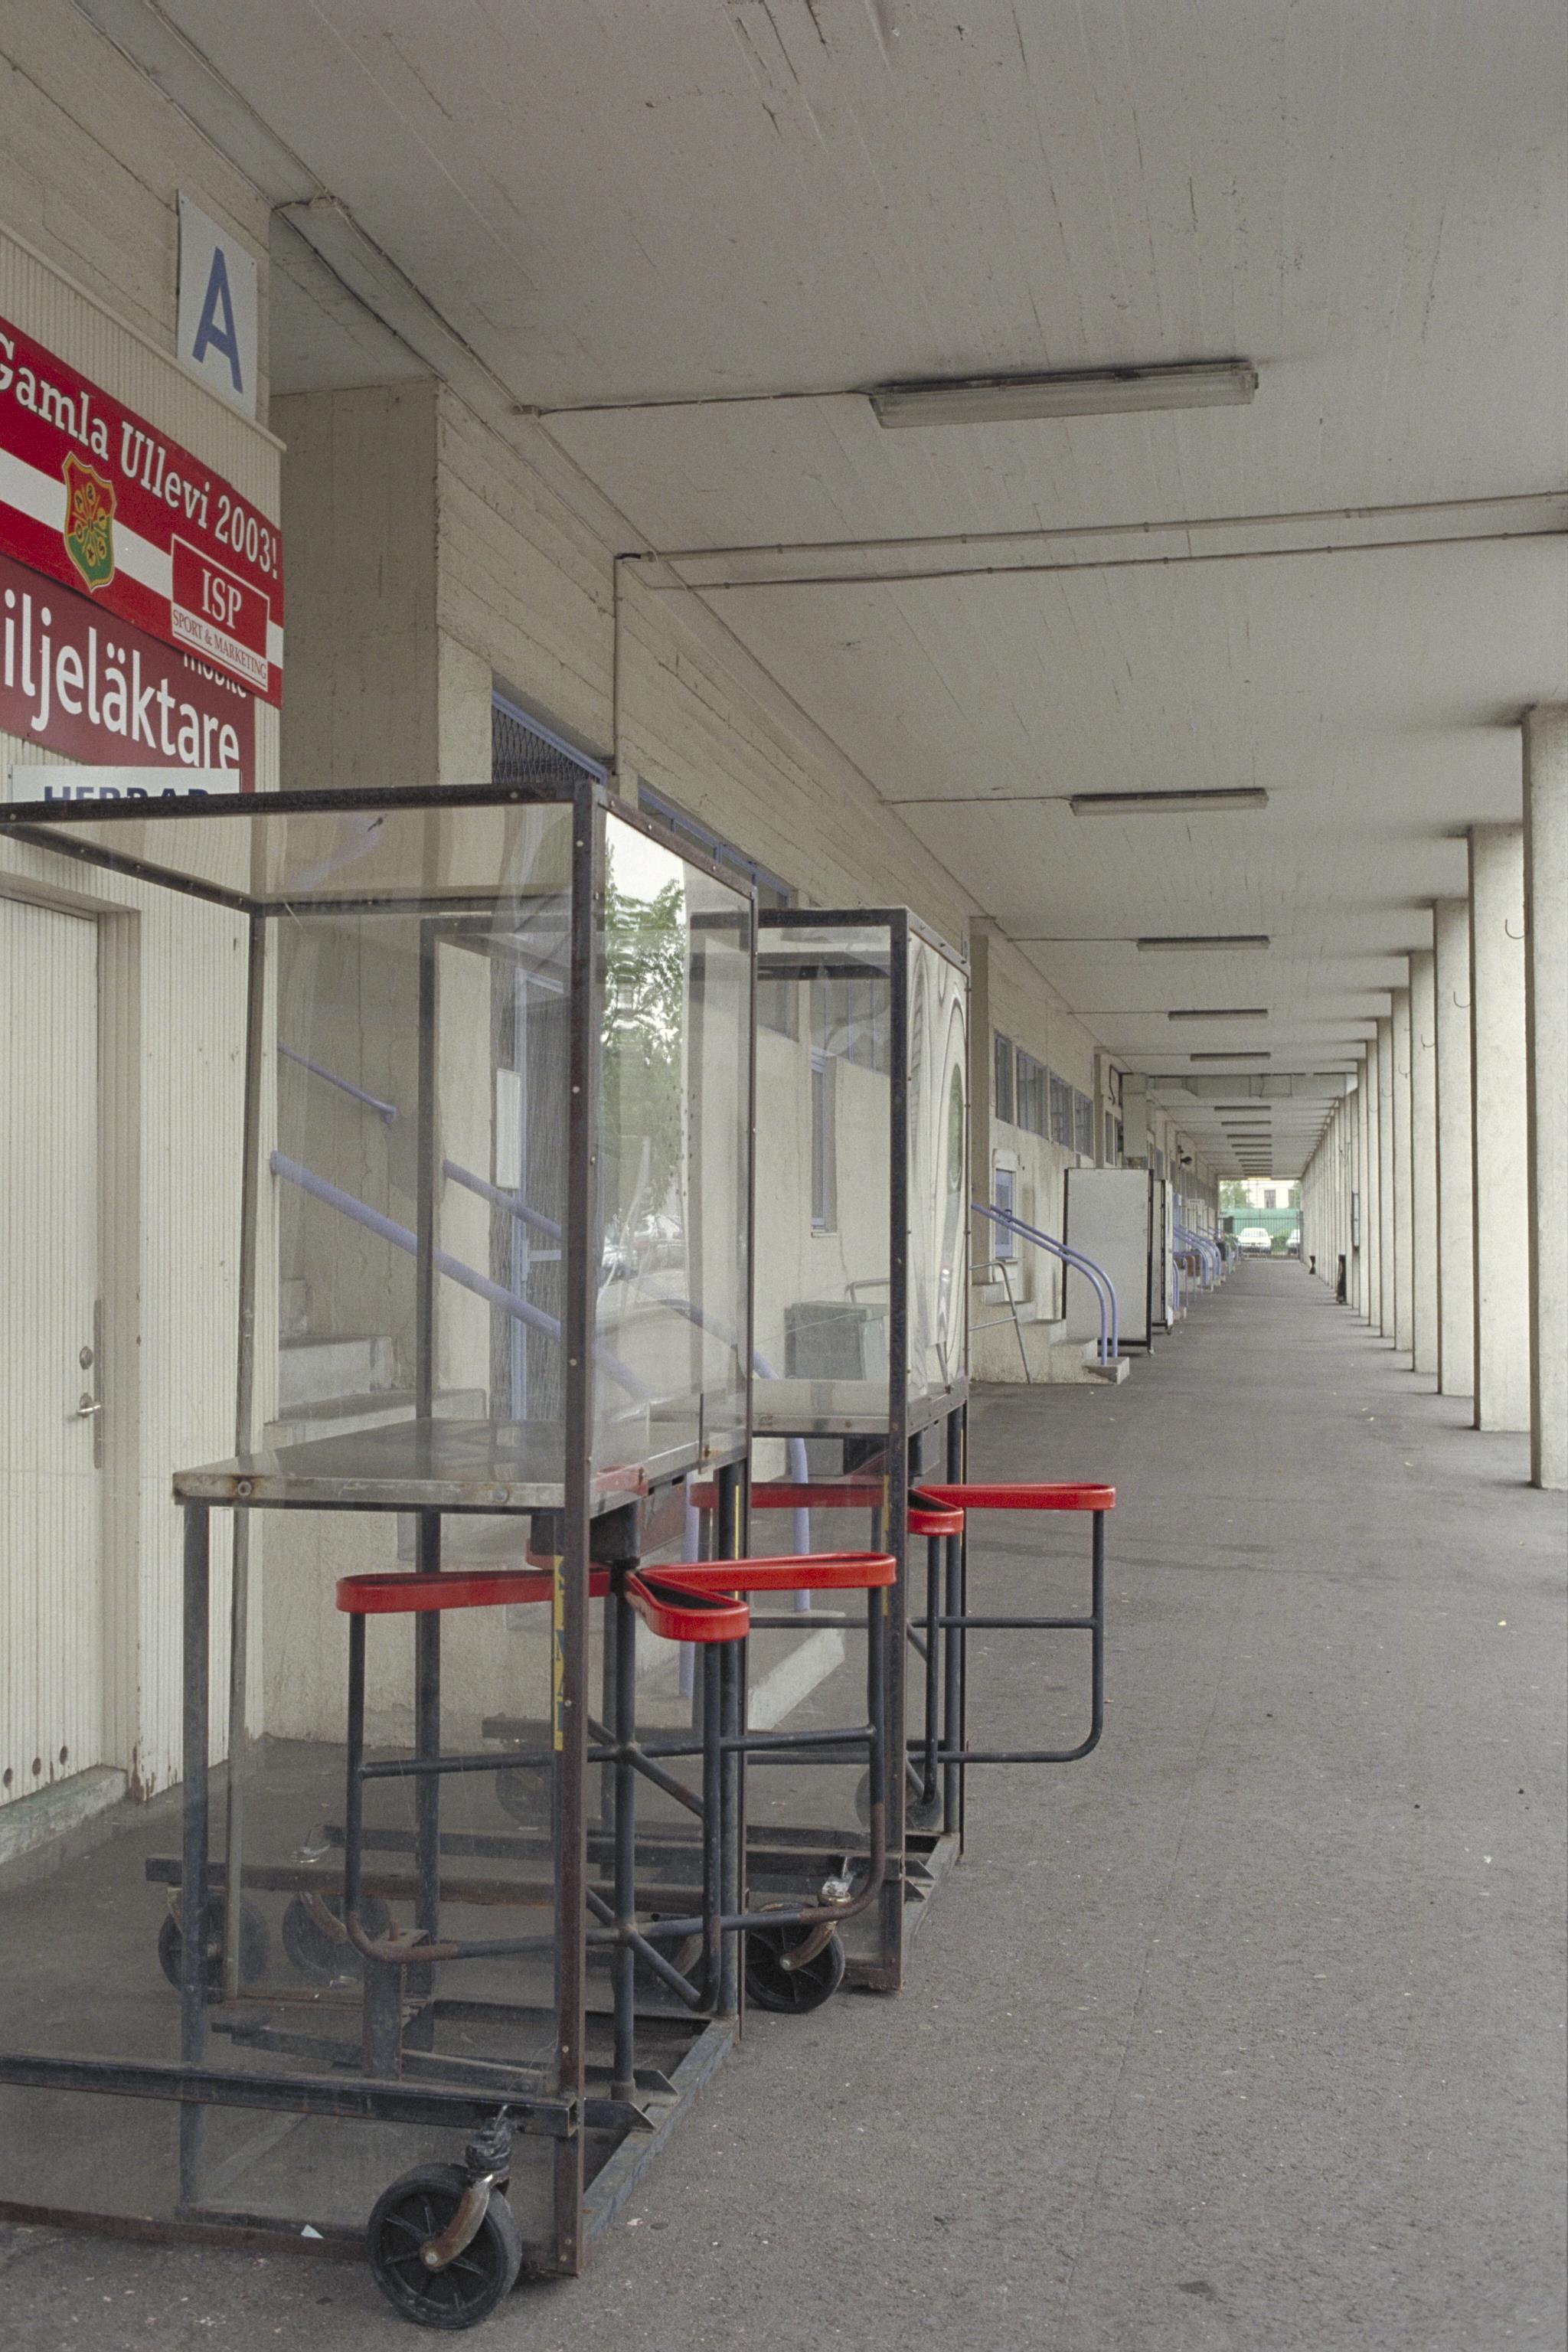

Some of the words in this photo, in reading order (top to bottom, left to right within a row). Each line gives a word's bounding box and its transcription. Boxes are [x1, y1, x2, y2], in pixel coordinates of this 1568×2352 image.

[191, 245, 243, 394] A
[121, 420, 210, 530] Ullevi
[215, 495, 278, 580] 2003!
[173, 609, 202, 637] SPORT
[204, 628, 212, 646] &
[214, 633, 267, 680] MARKETING
[201, 568, 242, 629] ISP
